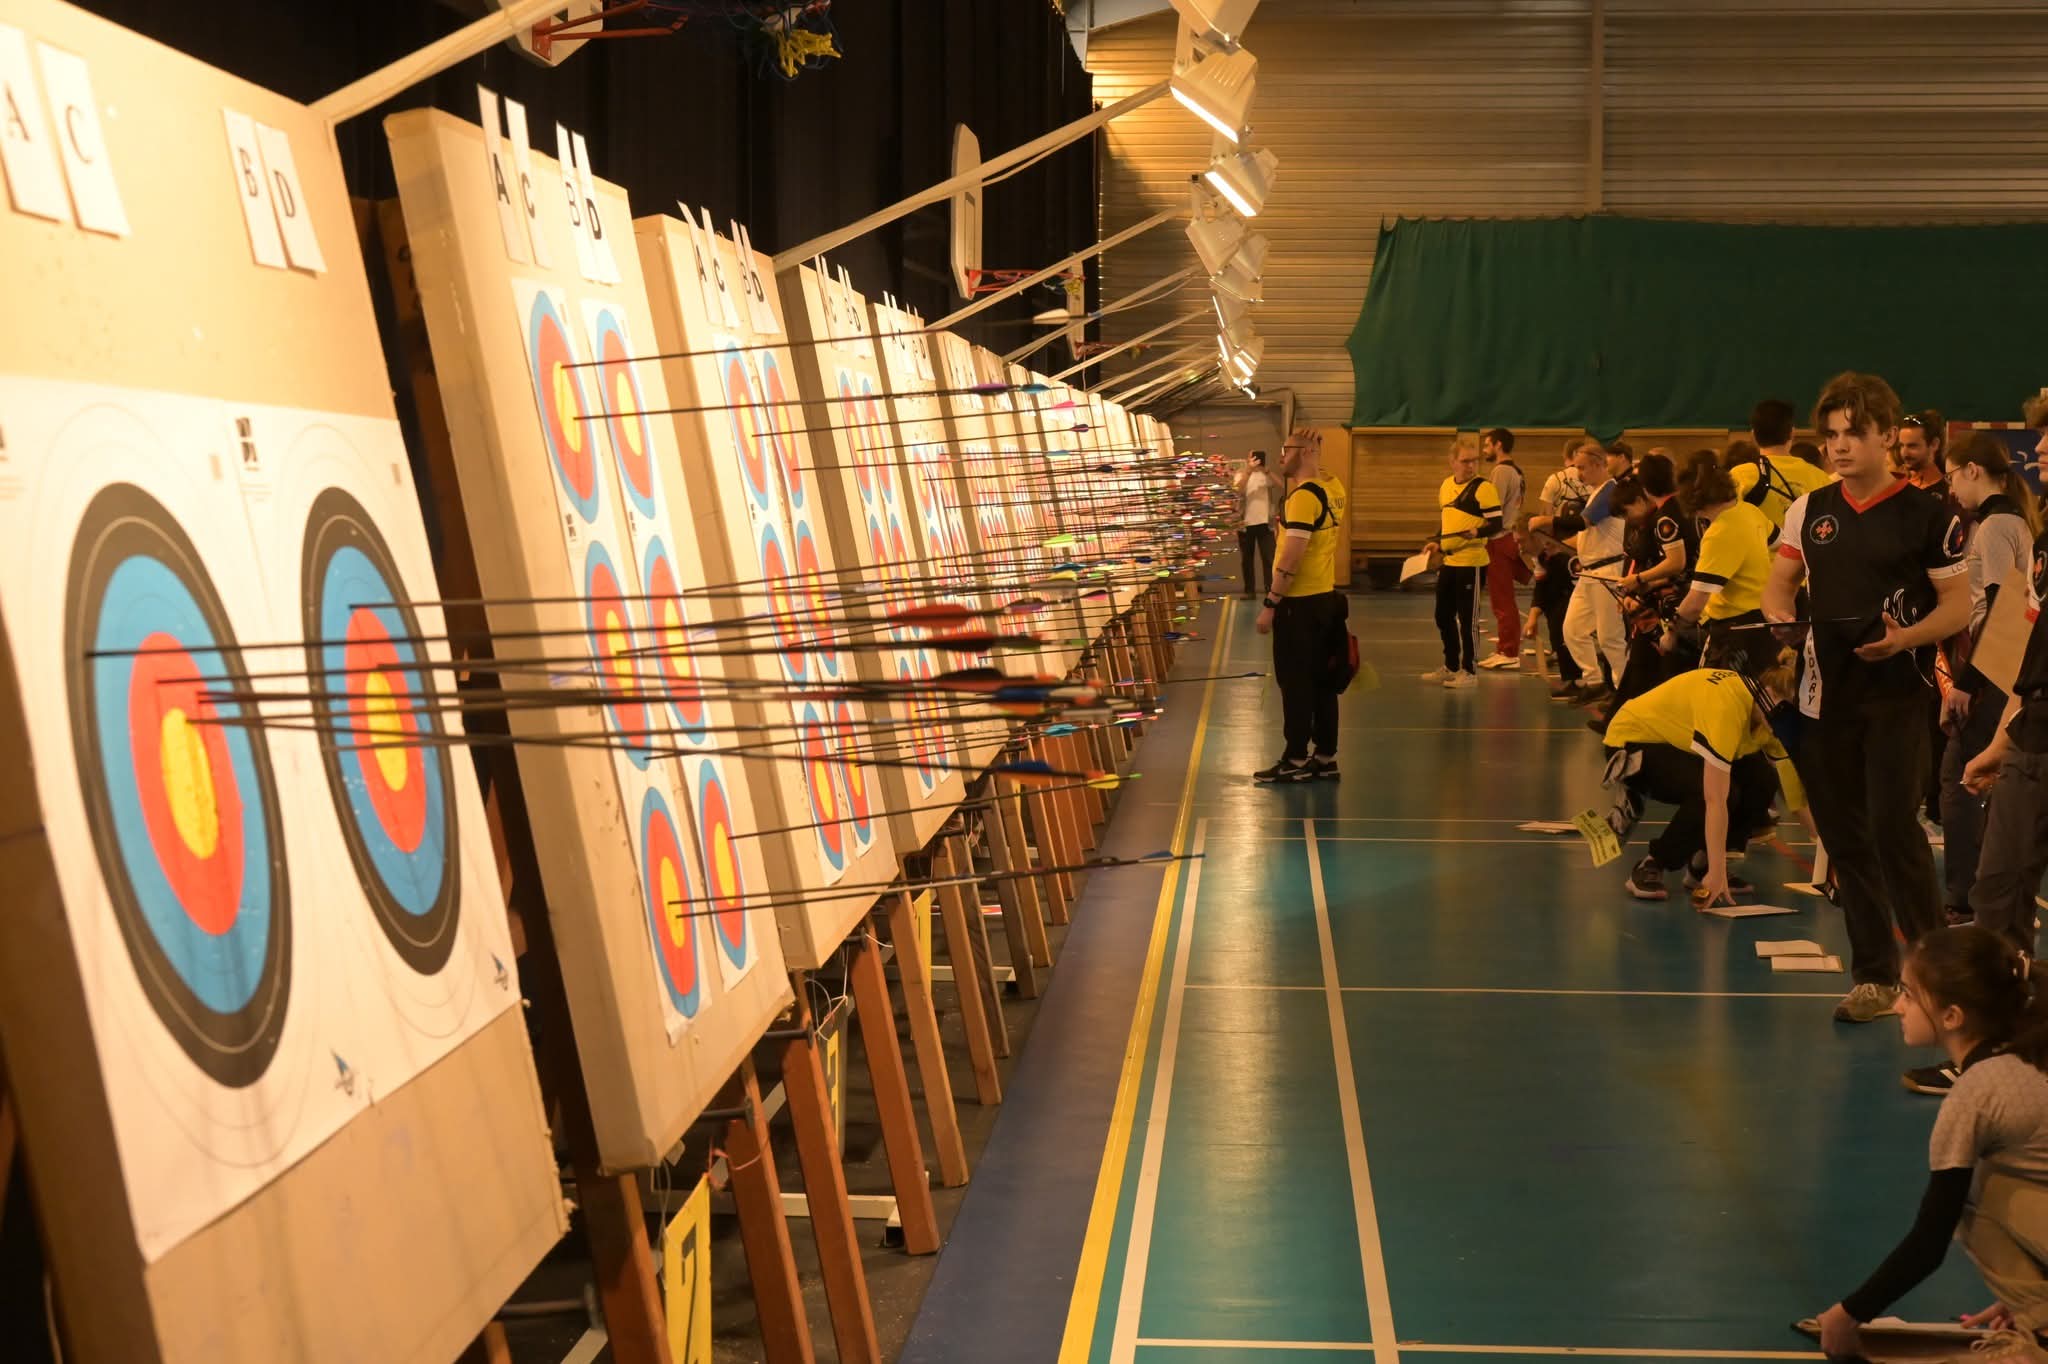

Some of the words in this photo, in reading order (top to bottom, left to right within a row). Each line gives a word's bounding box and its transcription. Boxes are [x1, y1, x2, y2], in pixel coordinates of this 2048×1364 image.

[4, 80, 30, 142] A
[66, 105, 94, 165] C
[239, 147, 258, 198] B
[274, 170, 296, 218] D
[493, 152, 510, 205] A
[521, 172, 536, 219] C
[565, 181, 581, 226] B
[585, 198, 602, 240] D
[696, 245, 708, 283] A
[713, 257, 725, 292] C
[739, 261, 752, 295] B
[751, 271, 764, 303] D
